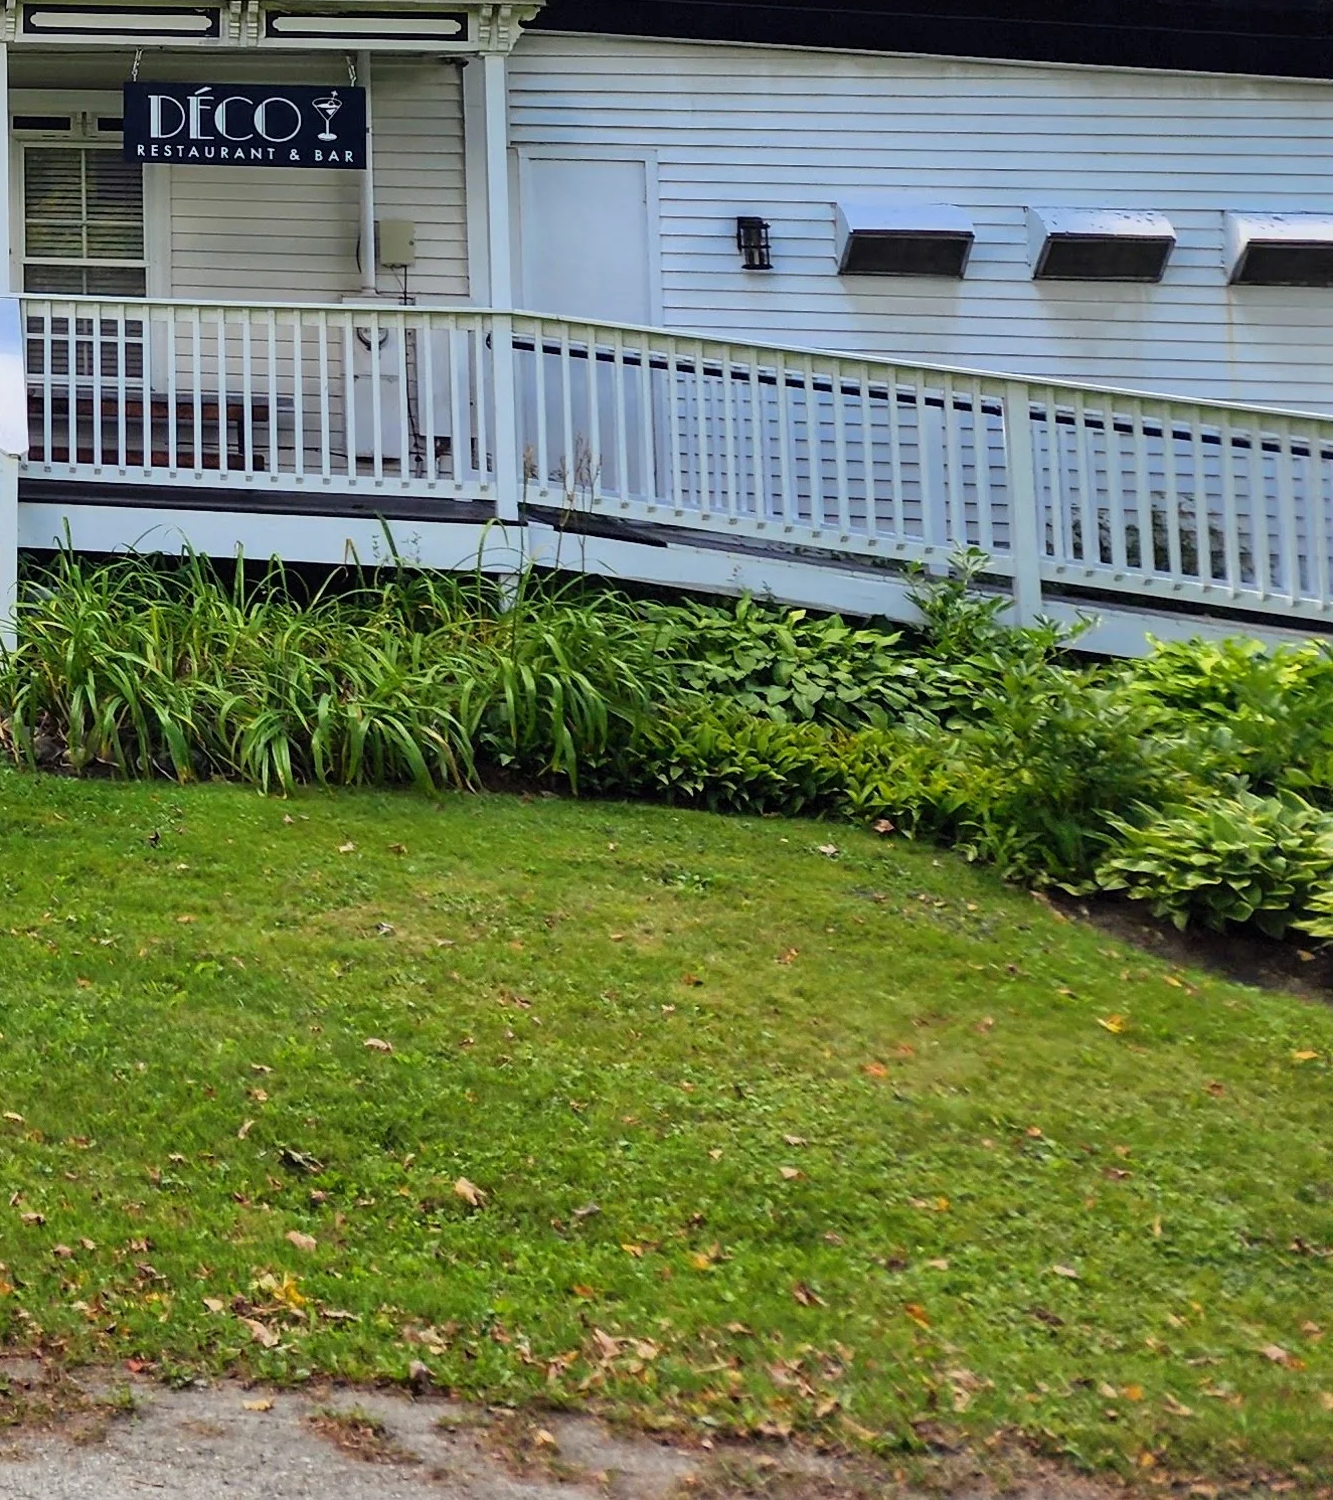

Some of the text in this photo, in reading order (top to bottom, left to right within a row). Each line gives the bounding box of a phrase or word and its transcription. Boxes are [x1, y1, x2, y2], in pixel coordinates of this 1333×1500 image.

[147, 86, 302, 142] DÉCO
[137, 144, 354, 163] RESTAURANT & BAR
